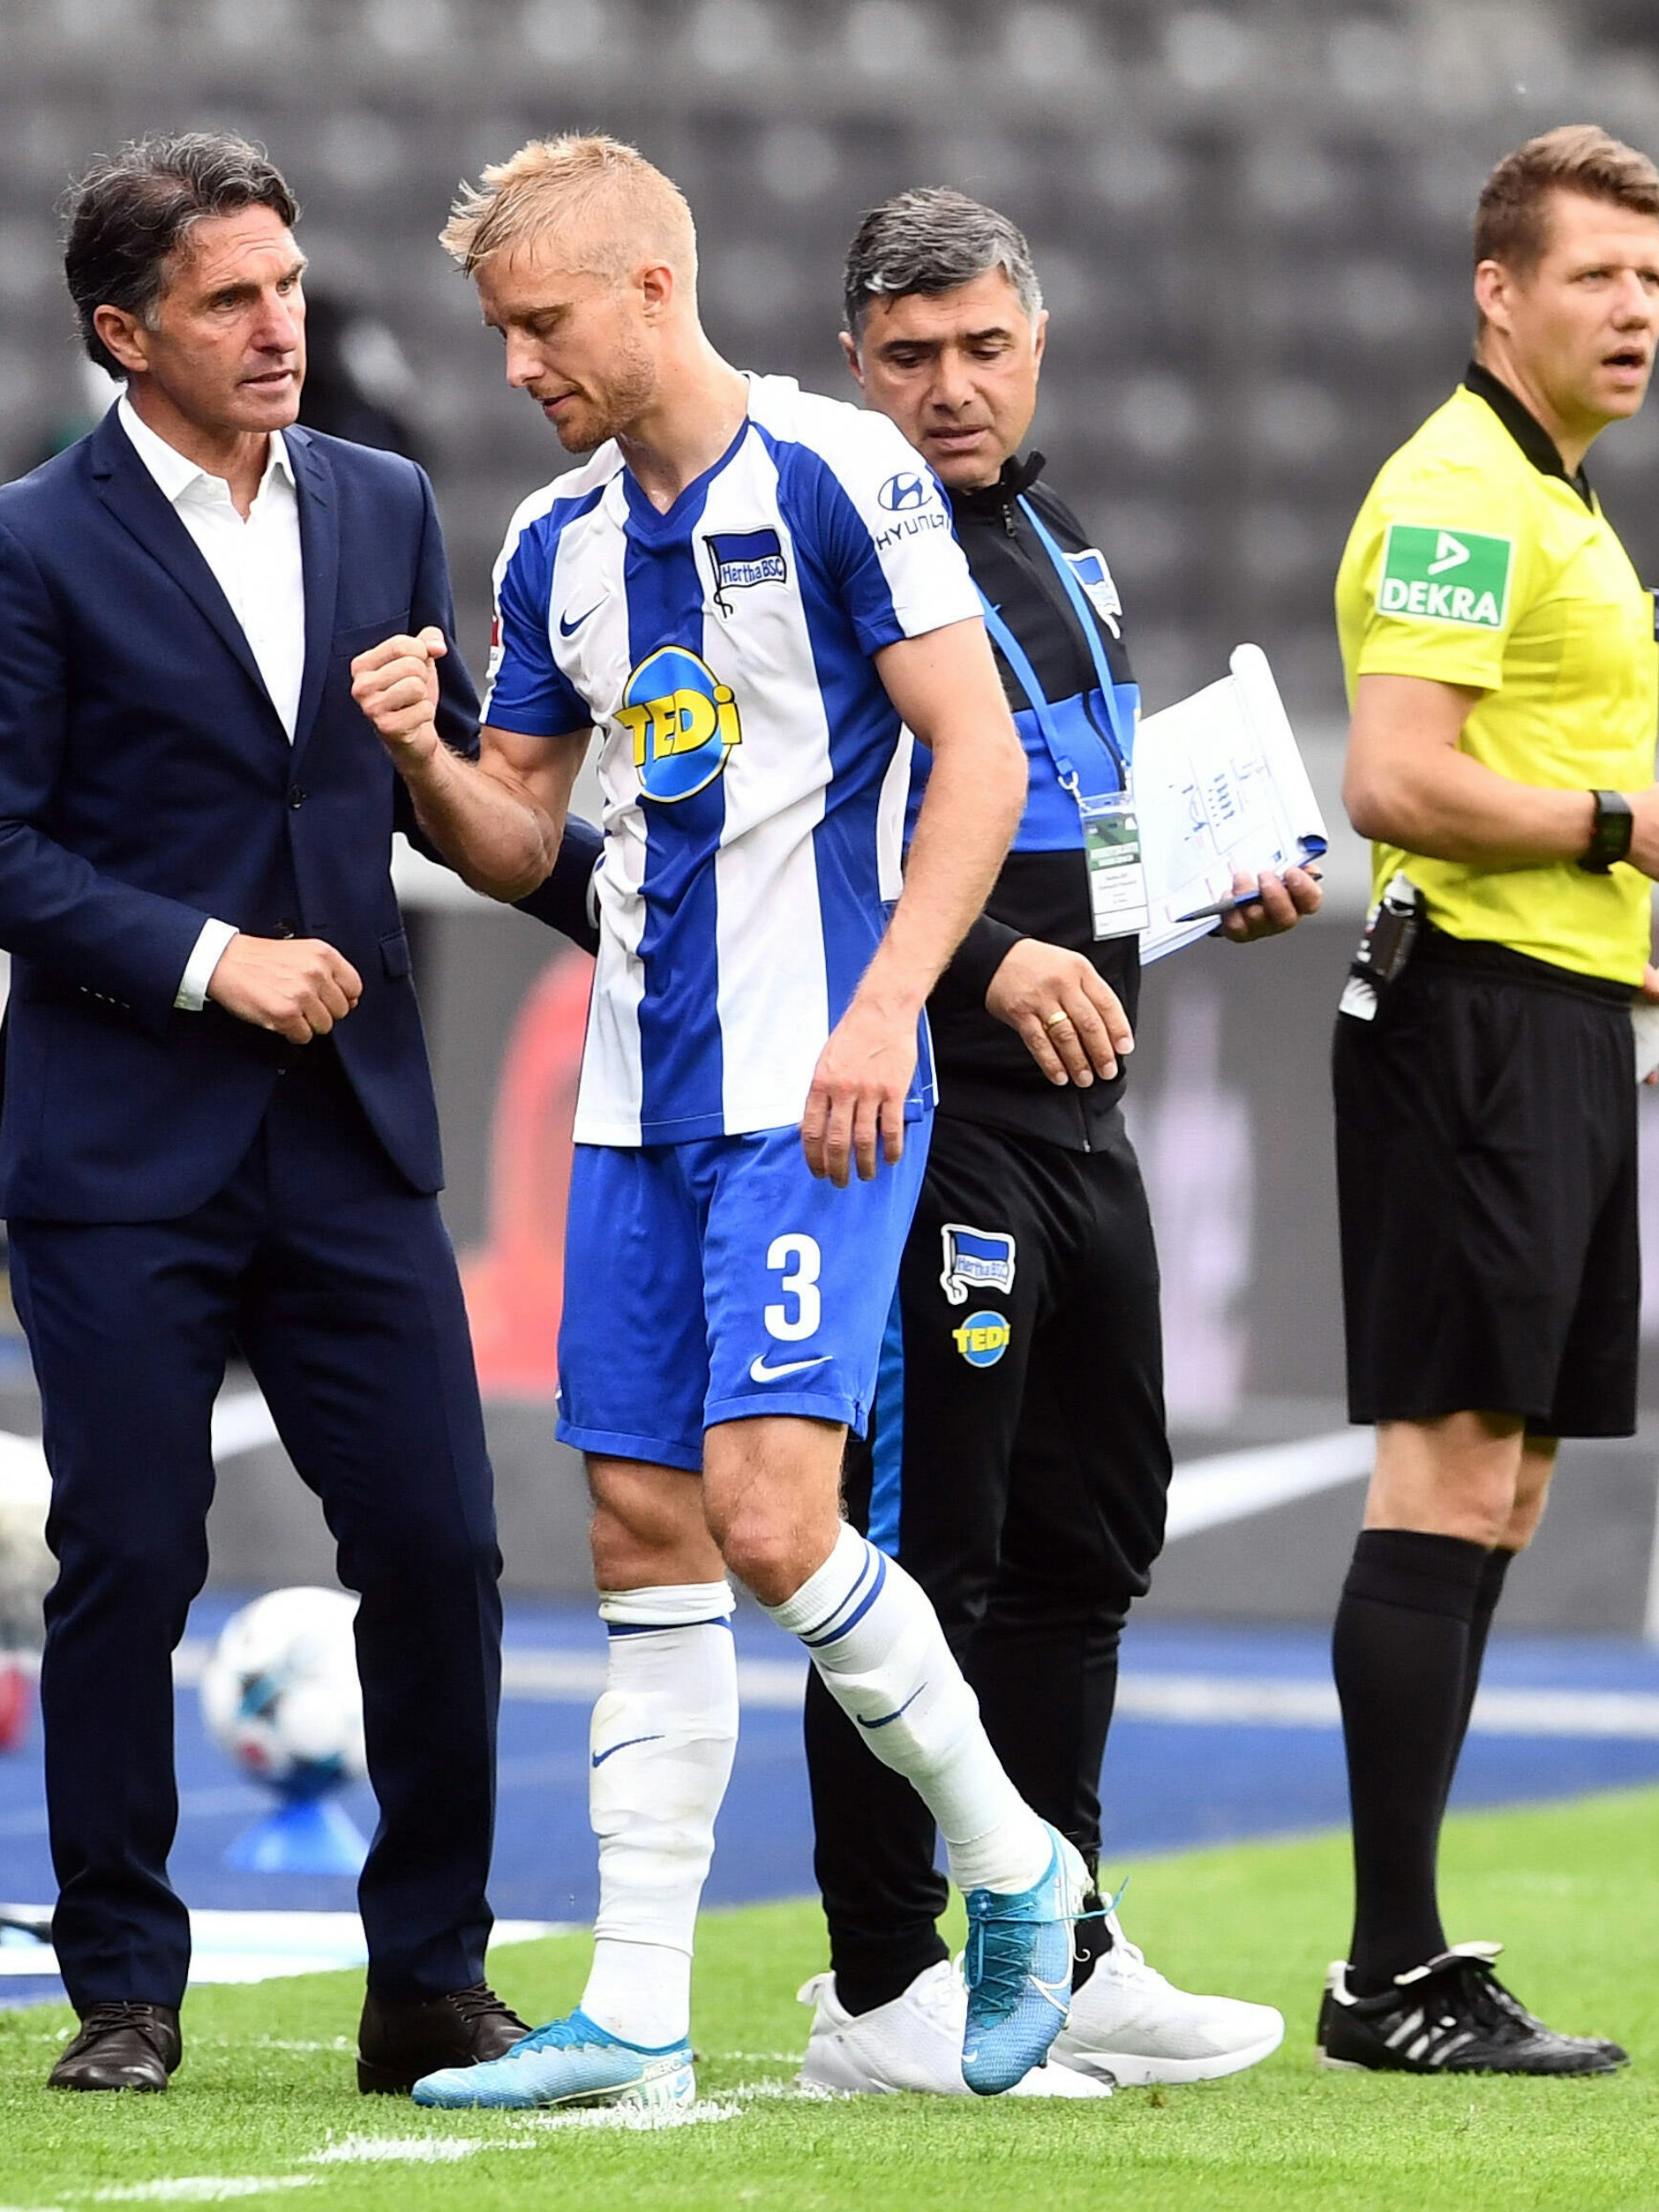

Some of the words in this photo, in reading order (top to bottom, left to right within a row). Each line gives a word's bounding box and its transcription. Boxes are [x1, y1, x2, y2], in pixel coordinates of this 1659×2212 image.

[722, 564, 762, 584] Hertha
[760, 558, 784, 578] BSC
[1382, 576, 1500, 626] DEKRA
[764, 1233, 821, 1341] 3
